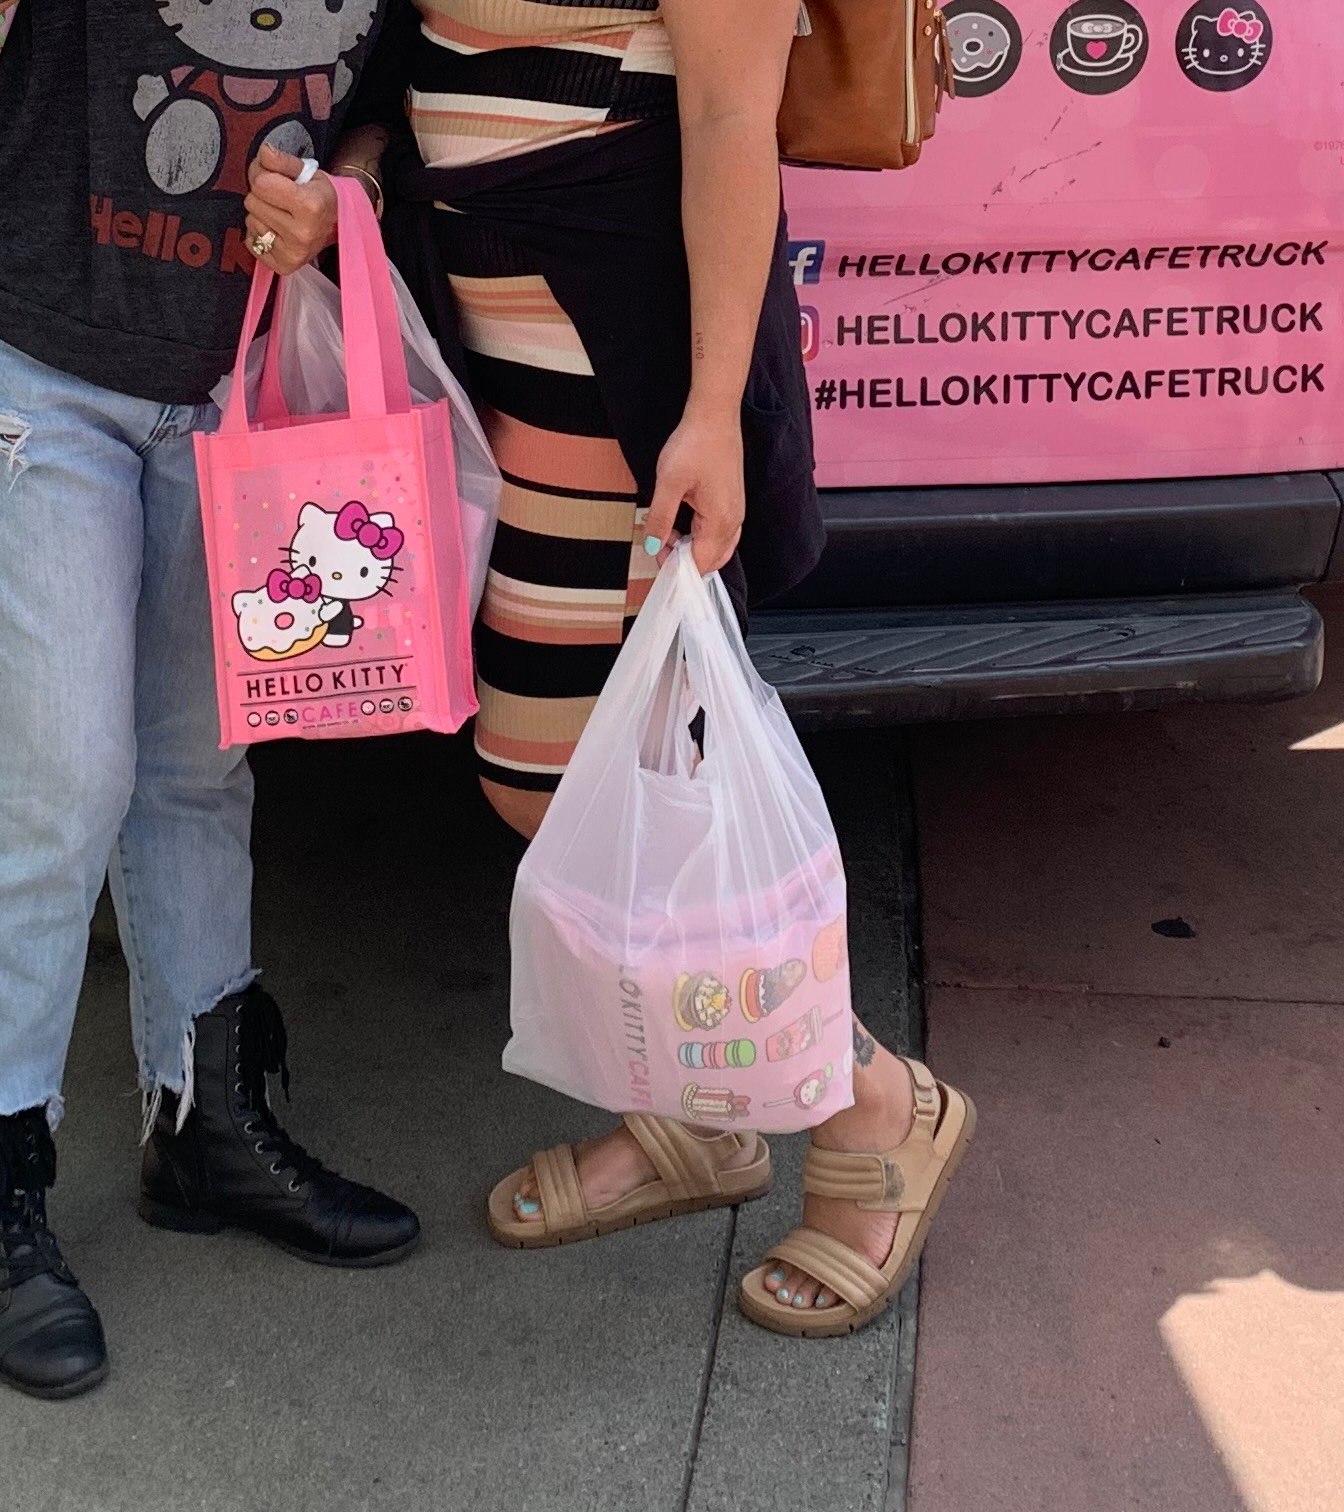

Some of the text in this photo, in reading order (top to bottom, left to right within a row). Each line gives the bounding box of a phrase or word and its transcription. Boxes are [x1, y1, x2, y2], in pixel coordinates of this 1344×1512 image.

[837, 240, 1329, 278] HELLOKITTYCAFETRUCK
[837, 301, 1324, 346] HELLOKITTYCAFETRUCK
[814, 362, 1325, 411] #HELLOKITTYCAFETRUCK
[246, 664, 405, 699] HELLO KITTY
[301, 701, 359, 724] CAFE
